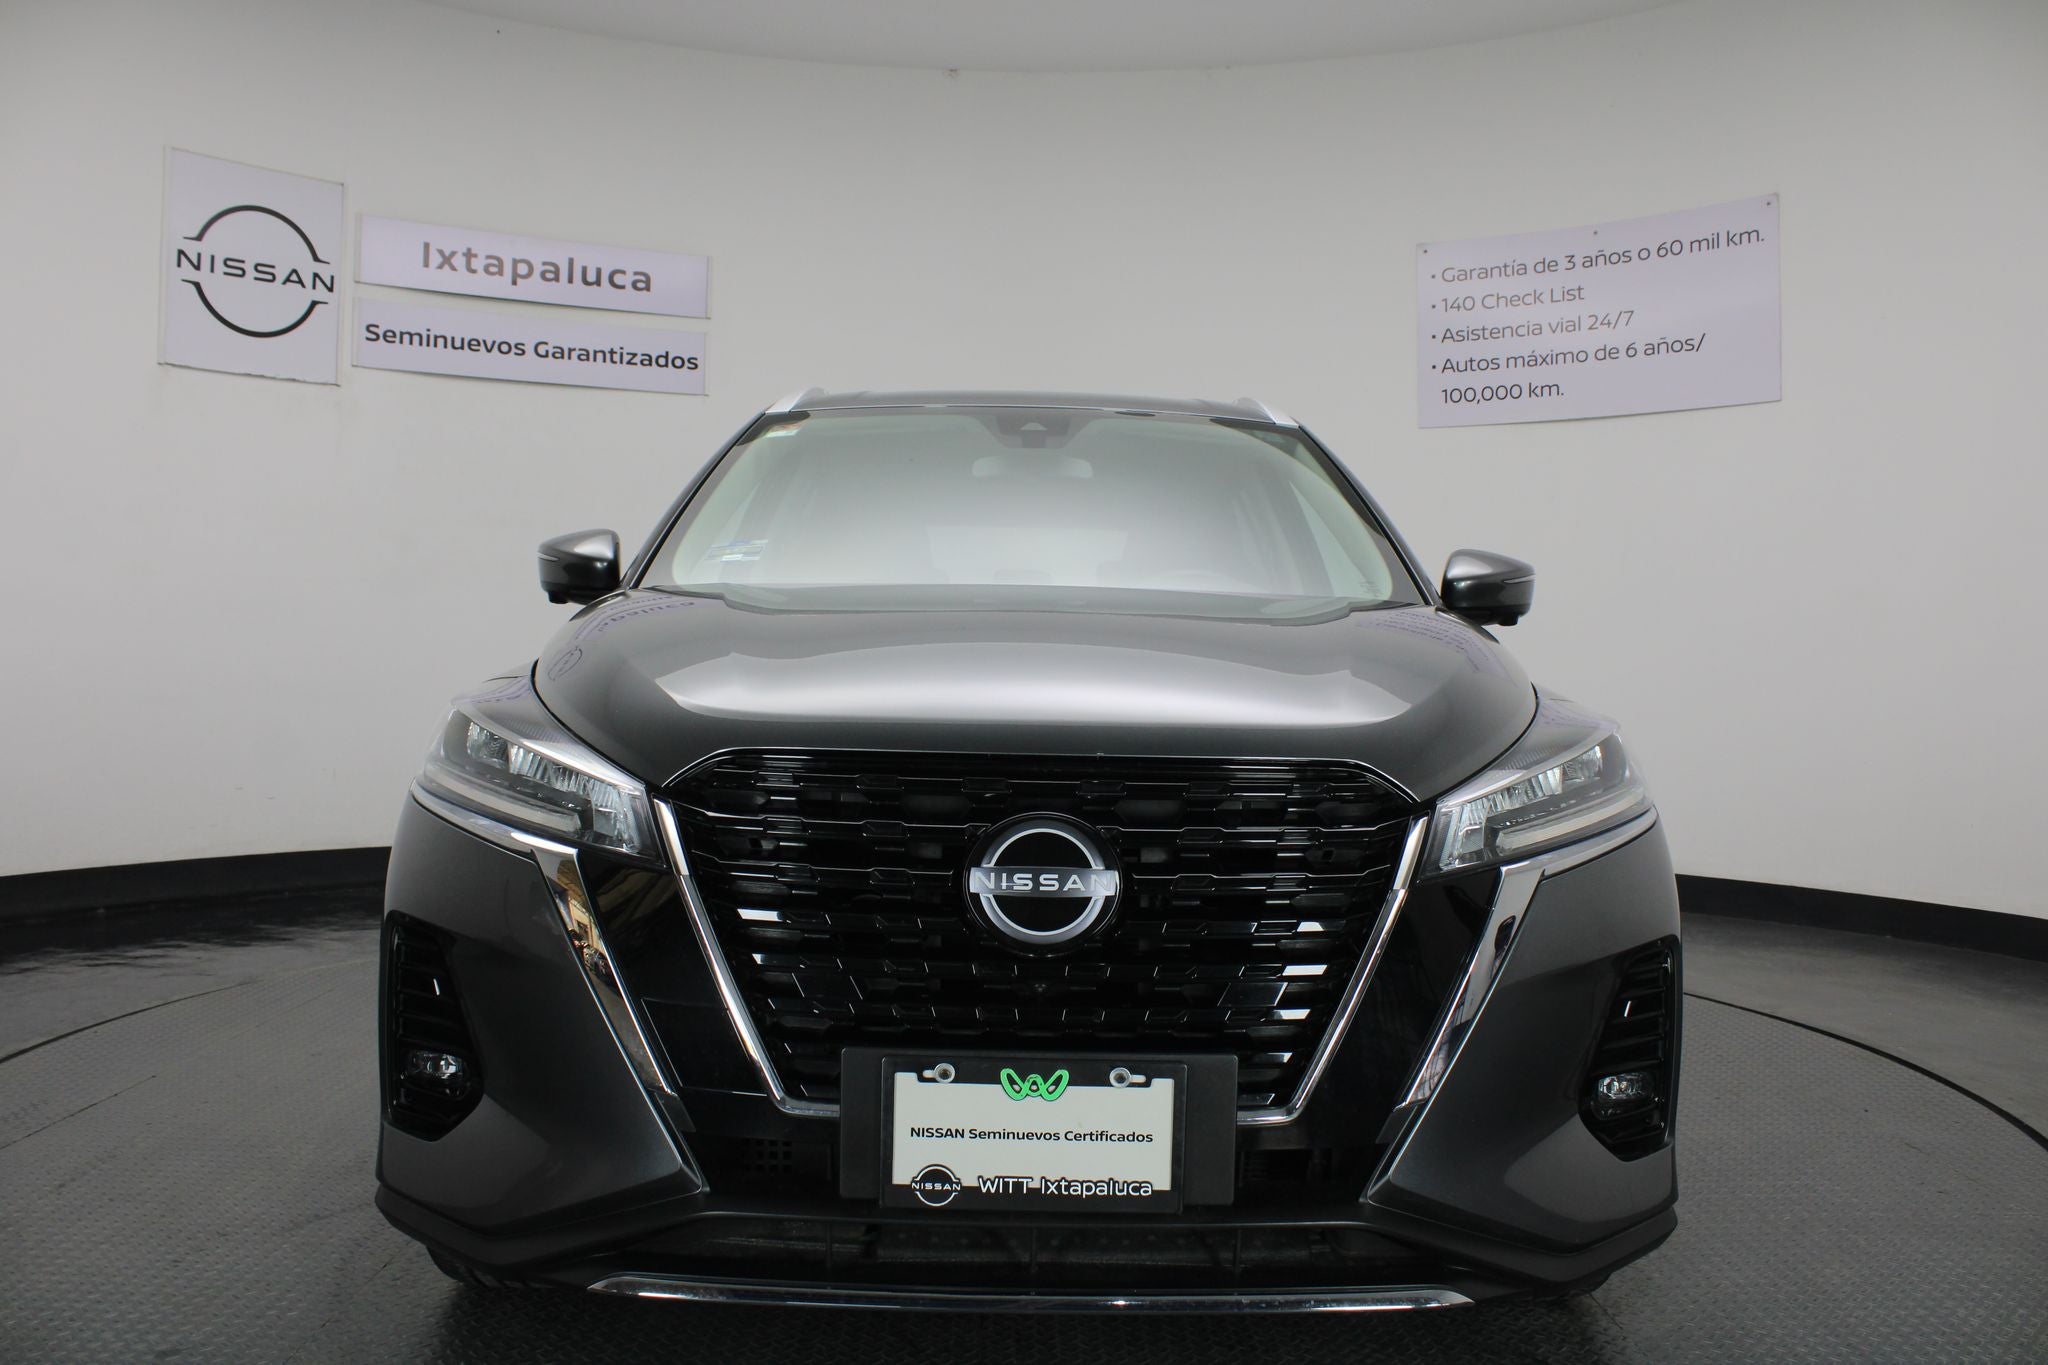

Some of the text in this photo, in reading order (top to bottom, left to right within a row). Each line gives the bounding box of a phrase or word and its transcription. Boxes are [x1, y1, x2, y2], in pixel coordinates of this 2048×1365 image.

[176, 248, 335, 293] NISSAN
[421, 241, 652, 293] Ixtapaluca
[1441, 228, 1766, 283] Garantía de 3 años o 60 mil km.
[1441, 285, 1585, 312] 140 Check List
[1441, 310, 1635, 343] Asistencia vial 24/7
[365, 323, 700, 371] Seminuevos Garantizados
[1441, 333, 1706, 374] Autos máximo de 6 años/
[1441, 381, 1565, 405] 100,000 km.
[975, 872, 1113, 892] NISSAN
[910, 1127, 1154, 1143] NISSAN Seminuevos Certificados
[911, 1181, 961, 1191] NISSAN
[978, 1176, 1152, 1199] WITT Ixtapaluca
